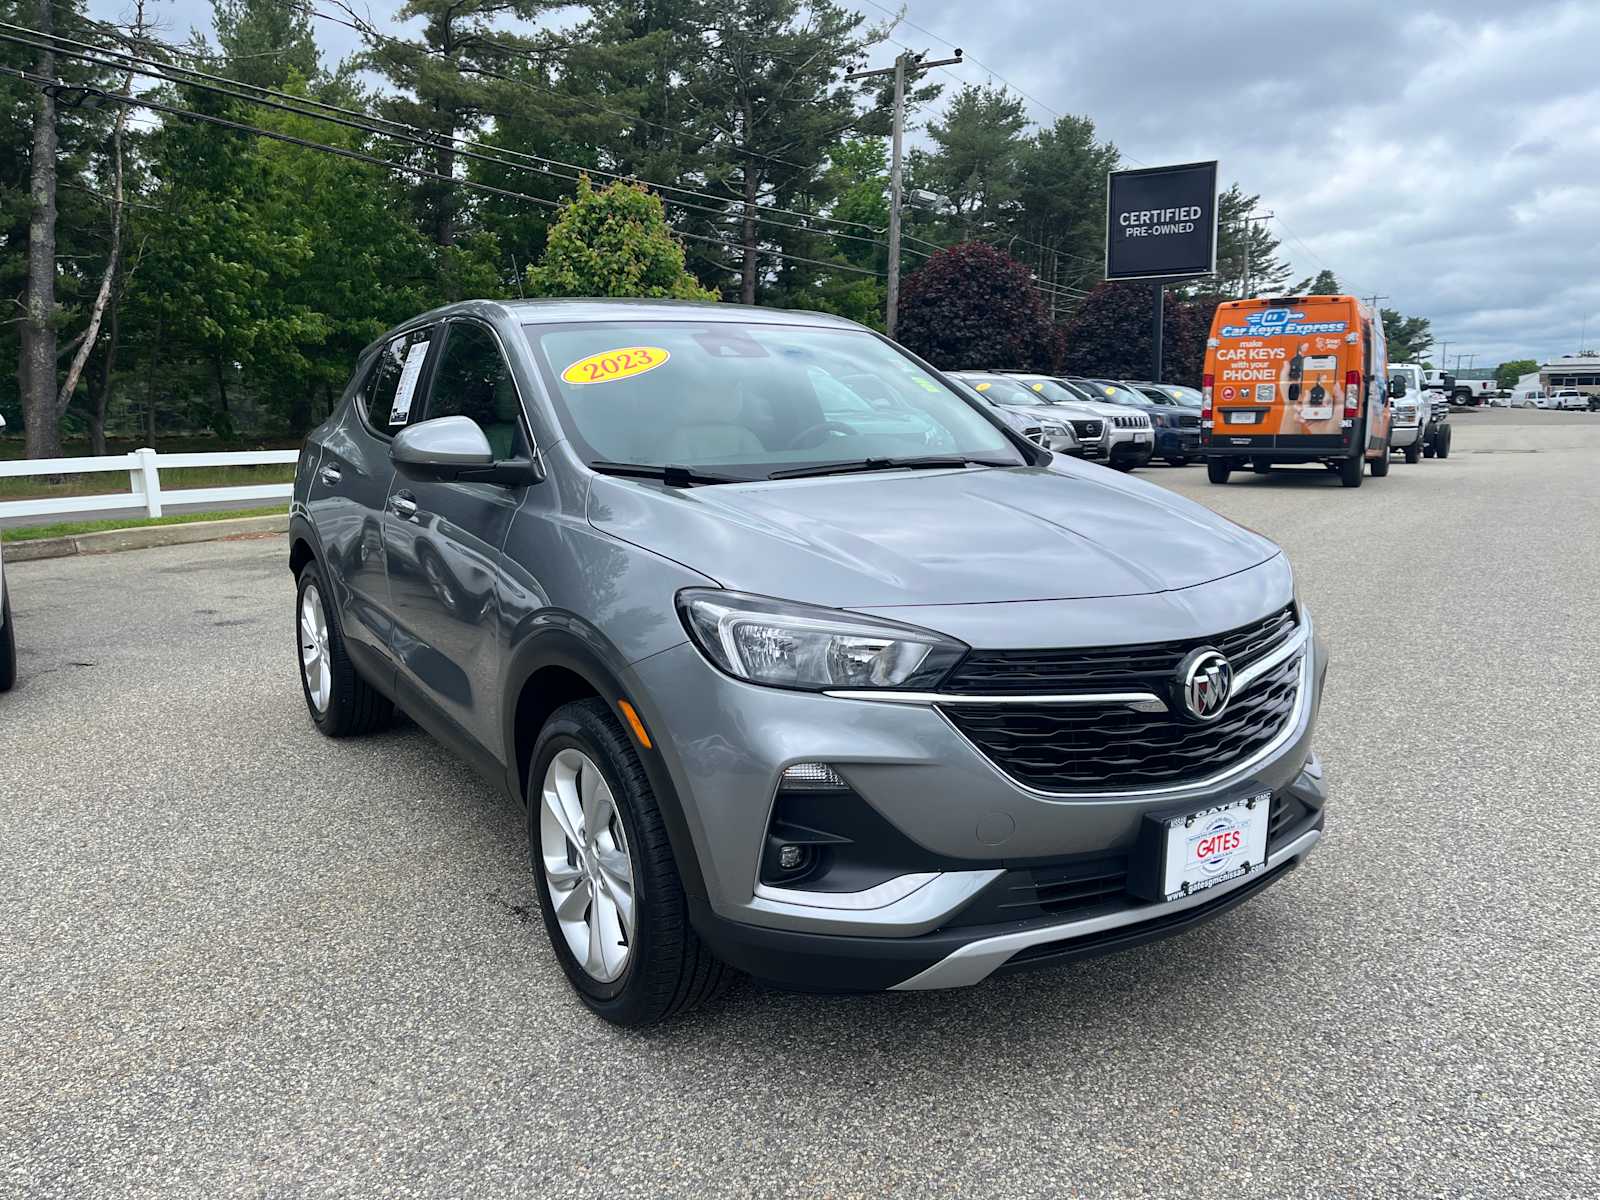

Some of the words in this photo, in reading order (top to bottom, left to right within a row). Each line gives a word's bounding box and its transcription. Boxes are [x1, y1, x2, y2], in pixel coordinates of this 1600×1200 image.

[1120, 206, 1201, 226] CERTIFIED
[1126, 222, 1194, 238] PRE-OWNED
[1221, 325, 1247, 337] Car
[1249, 324, 1281, 337] Keys
[1285, 322, 1345, 335] Express
[1240, 340, 1263, 348] make
[1216, 349, 1246, 360] CAR
[1249, 347, 1286, 360] KEYS
[583, 350, 653, 380] 2023
[1250, 361, 1270, 370] your
[1223, 369, 1276, 380] PHONE!
[1196, 831, 1241, 858] GATES
